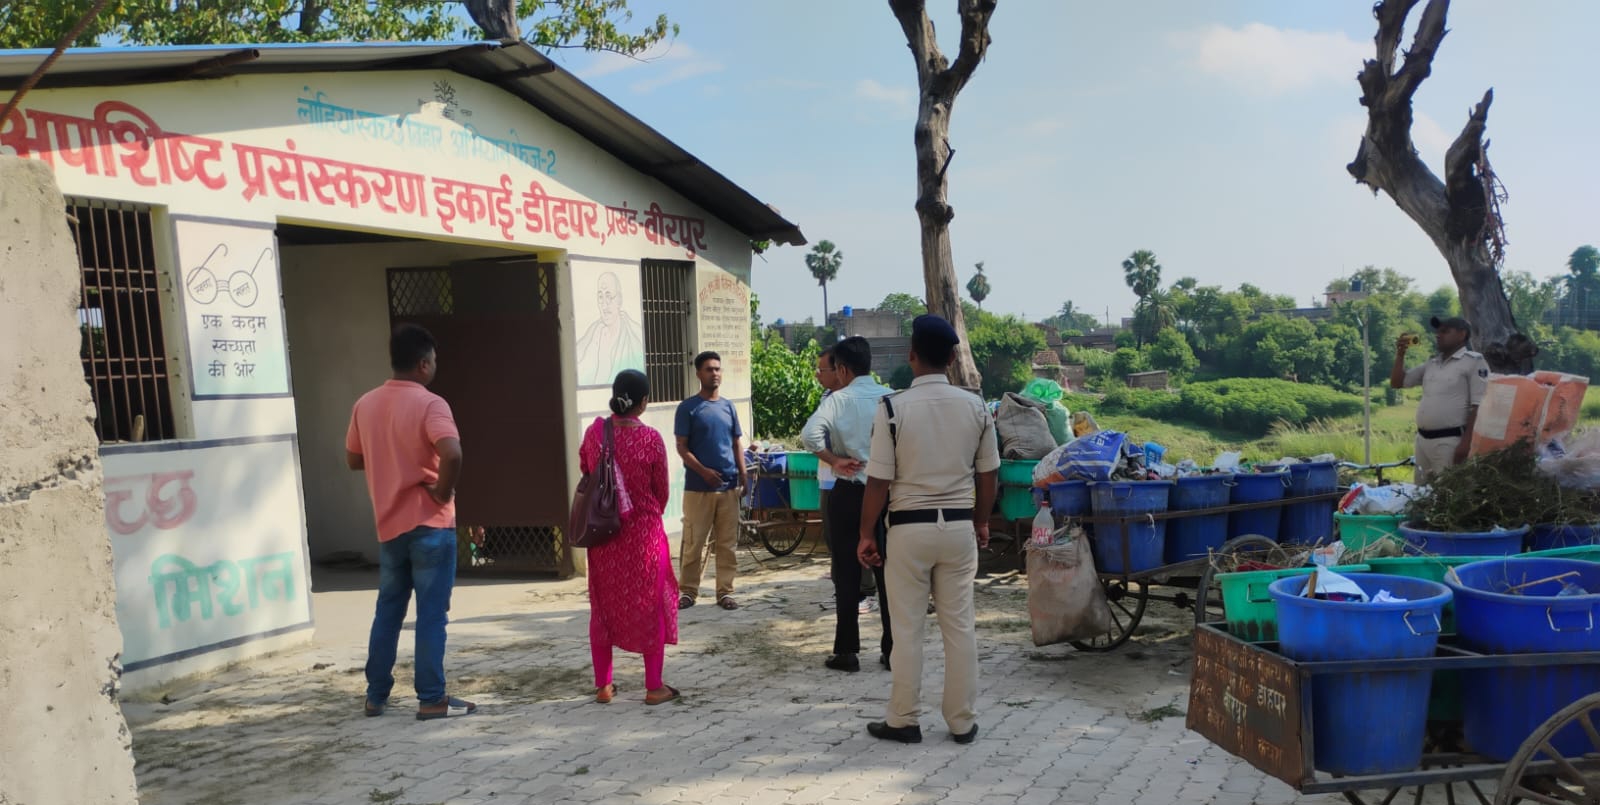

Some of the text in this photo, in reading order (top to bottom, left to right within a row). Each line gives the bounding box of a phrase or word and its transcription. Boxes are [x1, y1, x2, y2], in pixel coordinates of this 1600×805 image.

[231, 141, 429, 217] प्रसंस्करण
[201, 314, 267, 333] एक कदम
[208, 359, 226, 377] की
[103, 469, 197, 535] च्छ
[148, 553, 295, 629] मिशन
